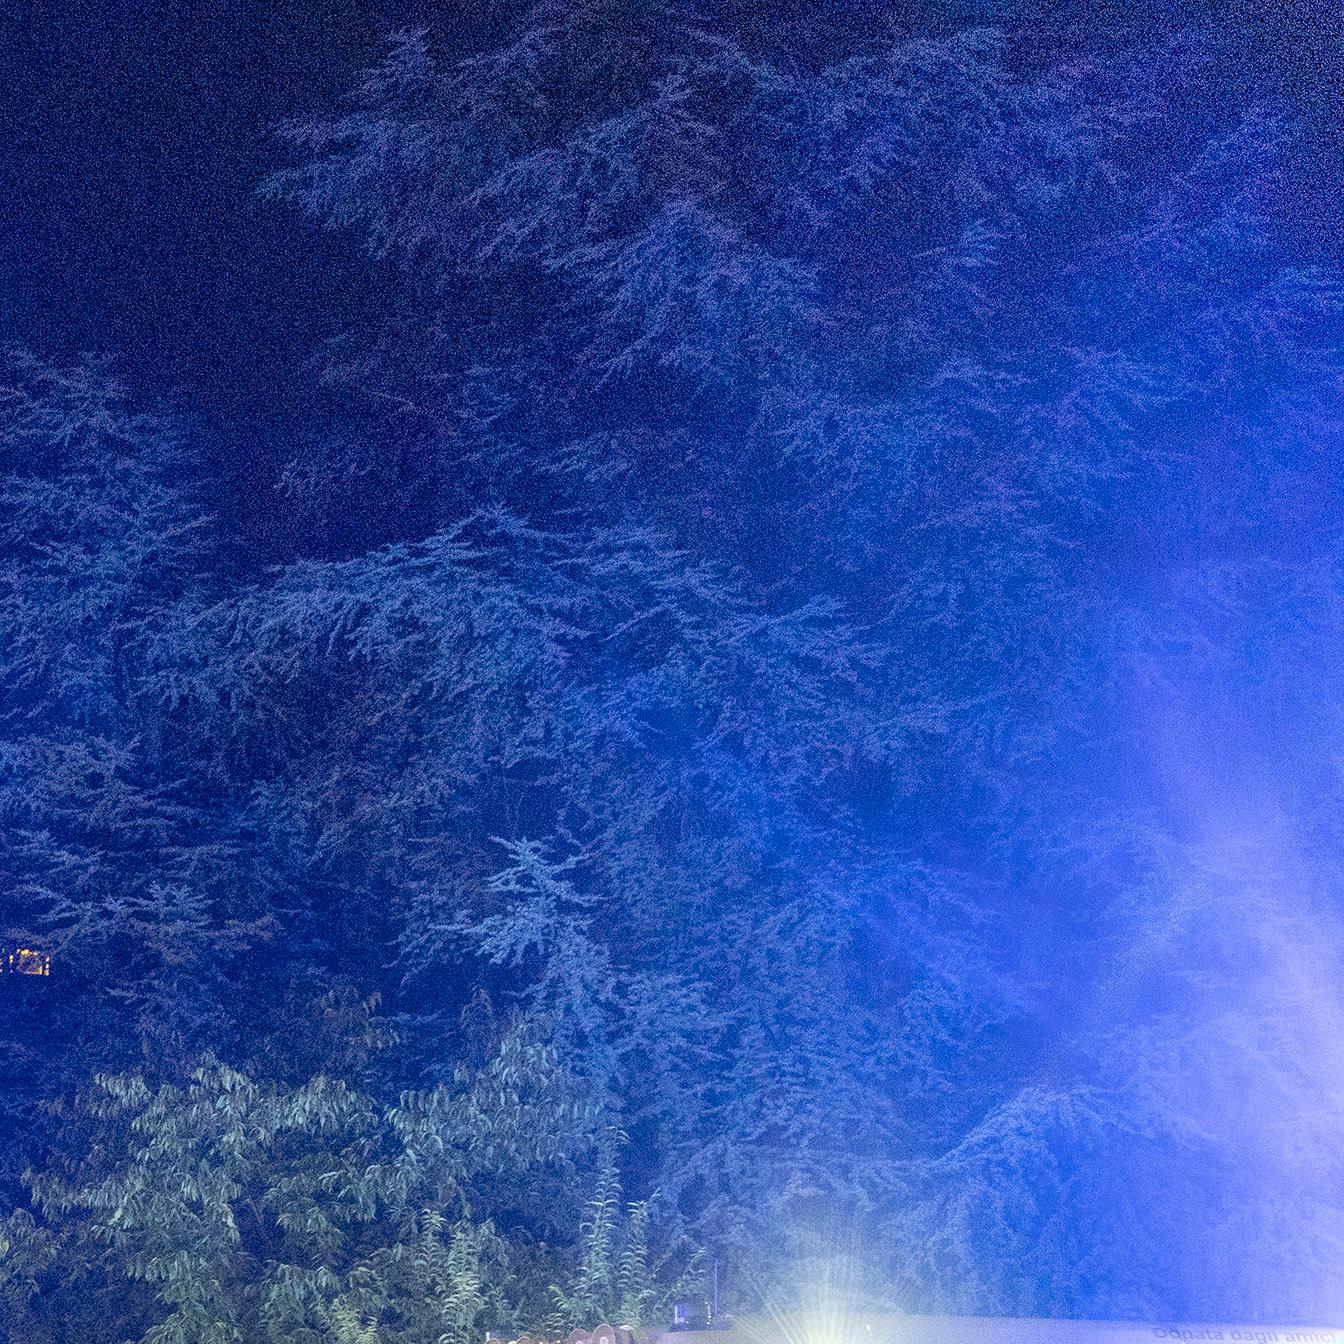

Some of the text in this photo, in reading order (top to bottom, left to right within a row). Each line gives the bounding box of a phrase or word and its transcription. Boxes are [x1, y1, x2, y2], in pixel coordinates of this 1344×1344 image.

[1152, 1326, 1338, 1344] Donata dagli amici
